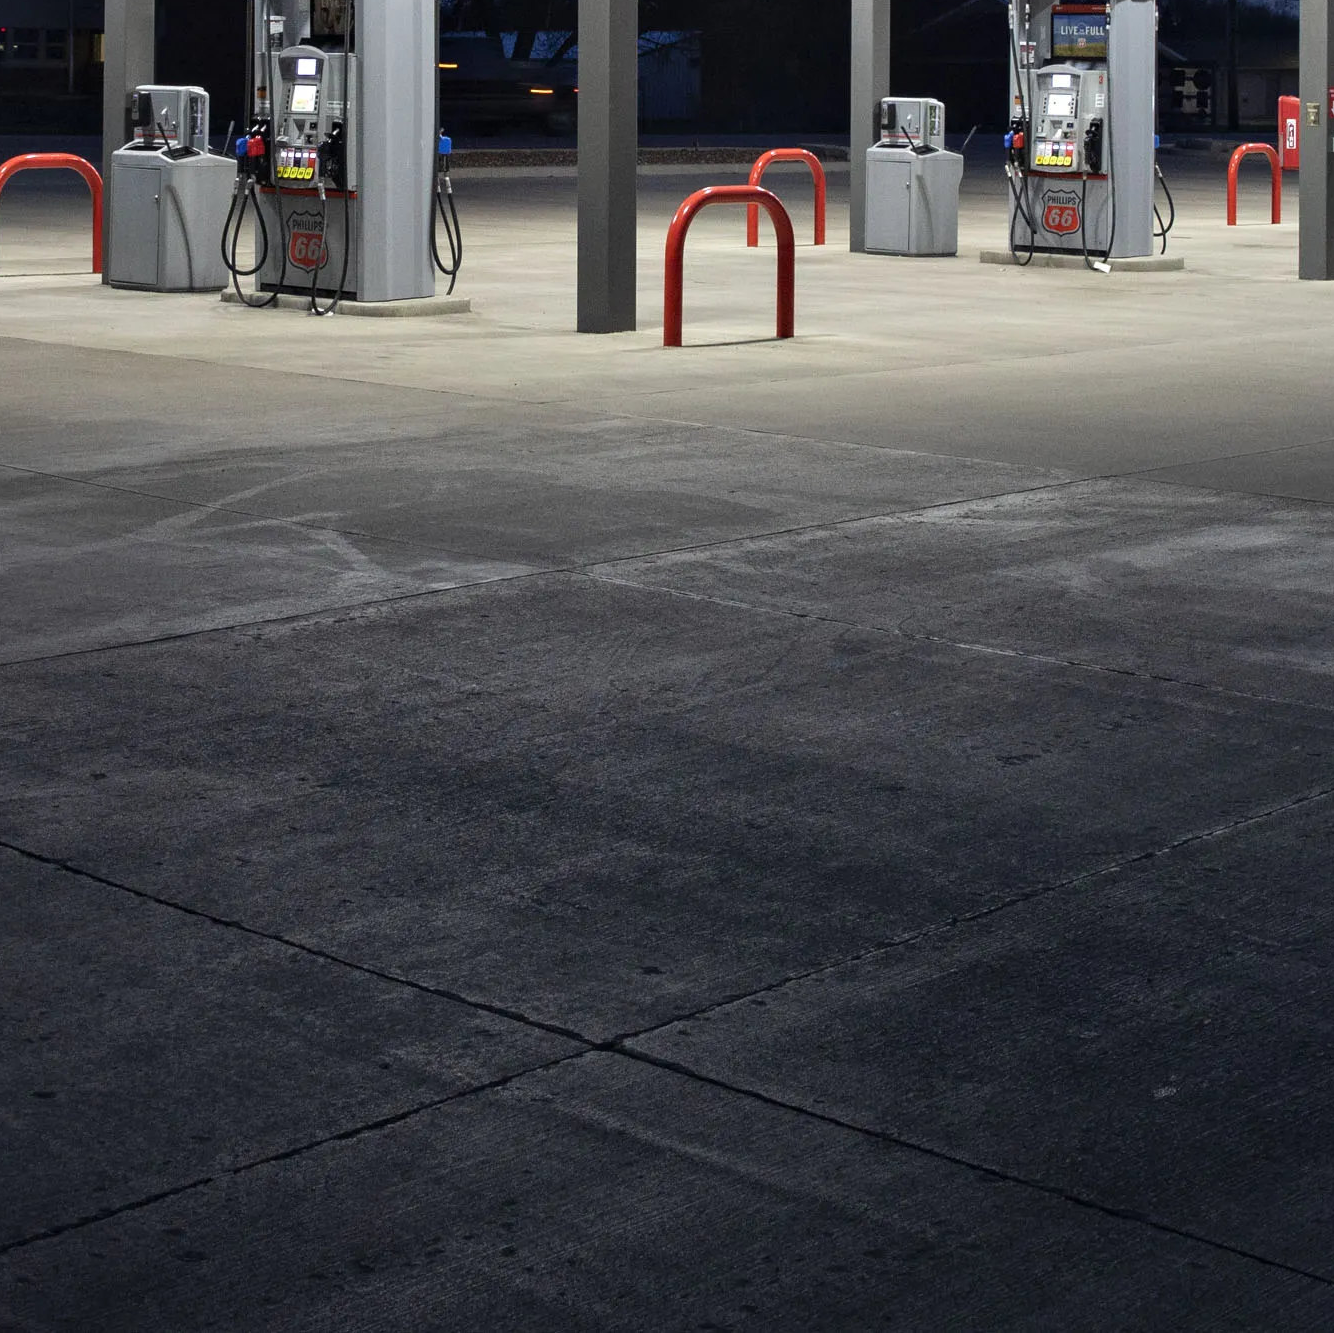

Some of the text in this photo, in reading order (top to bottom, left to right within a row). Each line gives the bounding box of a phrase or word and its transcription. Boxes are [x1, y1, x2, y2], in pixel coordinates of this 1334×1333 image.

[1060, 26, 1079, 35] LIVE
[1085, 26, 1105, 36] FULL
[1047, 195, 1077, 205] PHILLIPS
[1048, 209, 1074, 227] 66
[294, 236, 321, 260] 66
